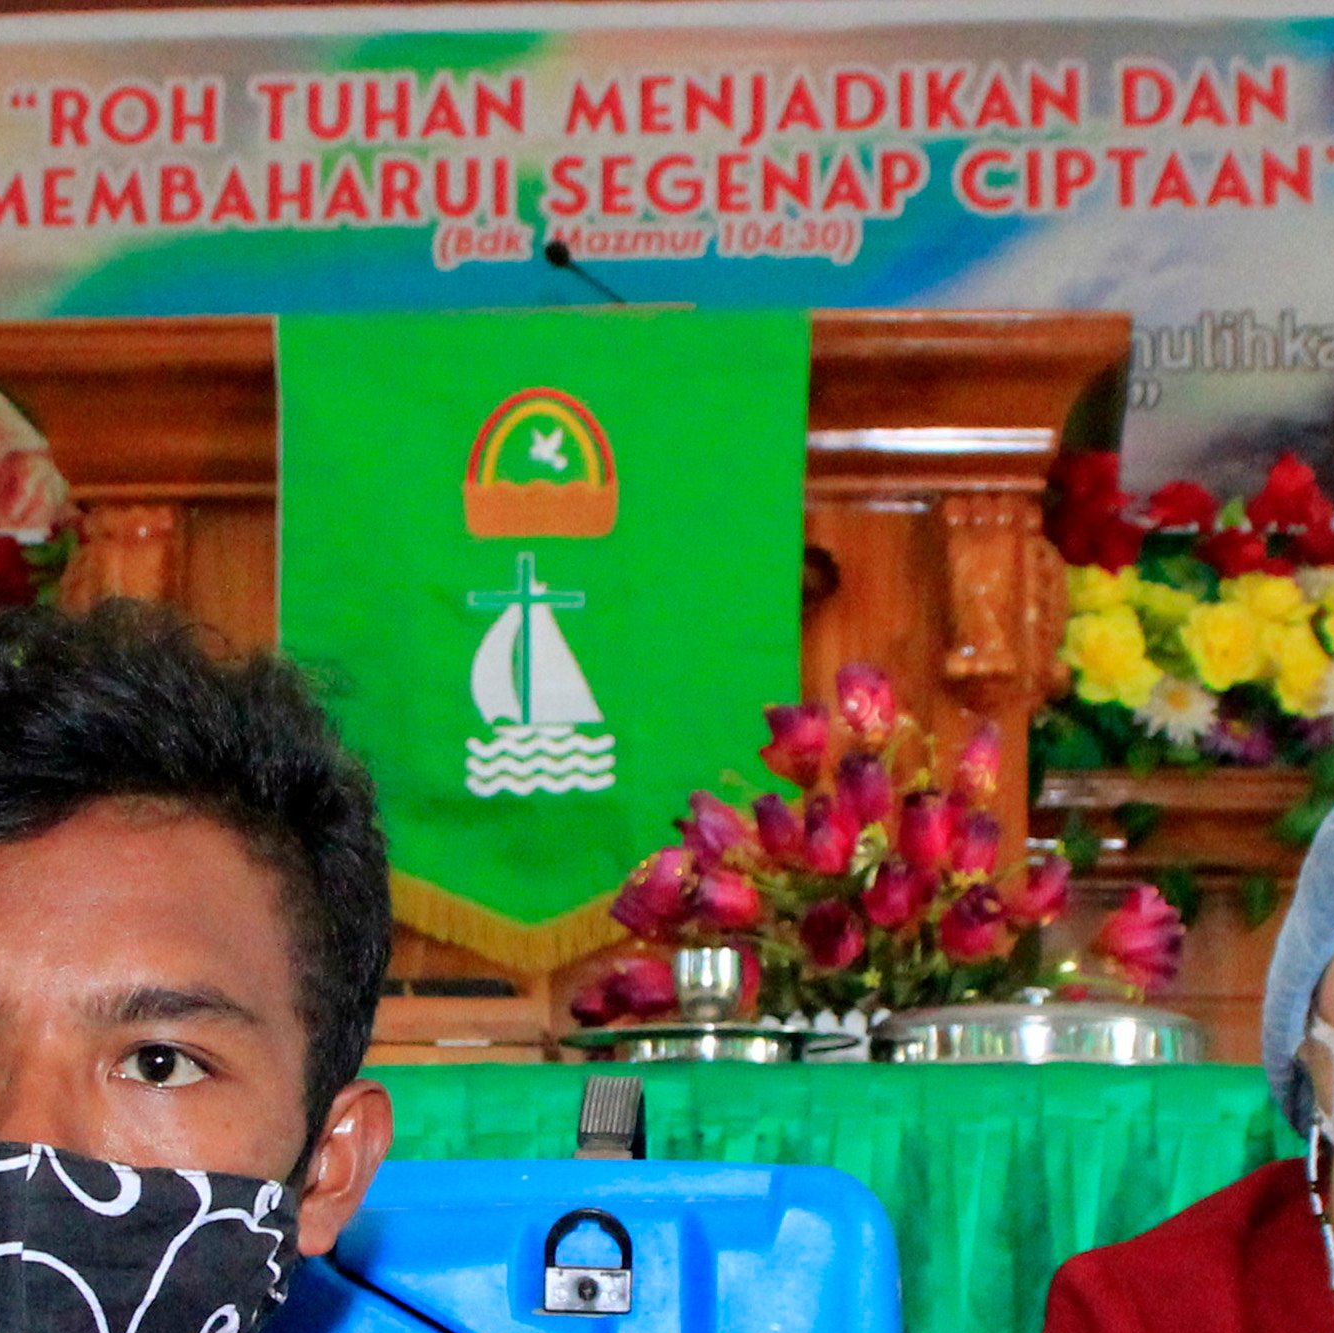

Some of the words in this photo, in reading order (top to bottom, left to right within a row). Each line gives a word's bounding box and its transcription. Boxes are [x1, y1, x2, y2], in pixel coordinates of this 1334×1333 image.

[10, 84, 218, 149] “ROH
[257, 76, 525, 142] TUHAN
[564, 67, 1080, 147] MENJADIKAN
[1120, 64, 1287, 129] DAN
[549, 152, 923, 218] SEGENAP
